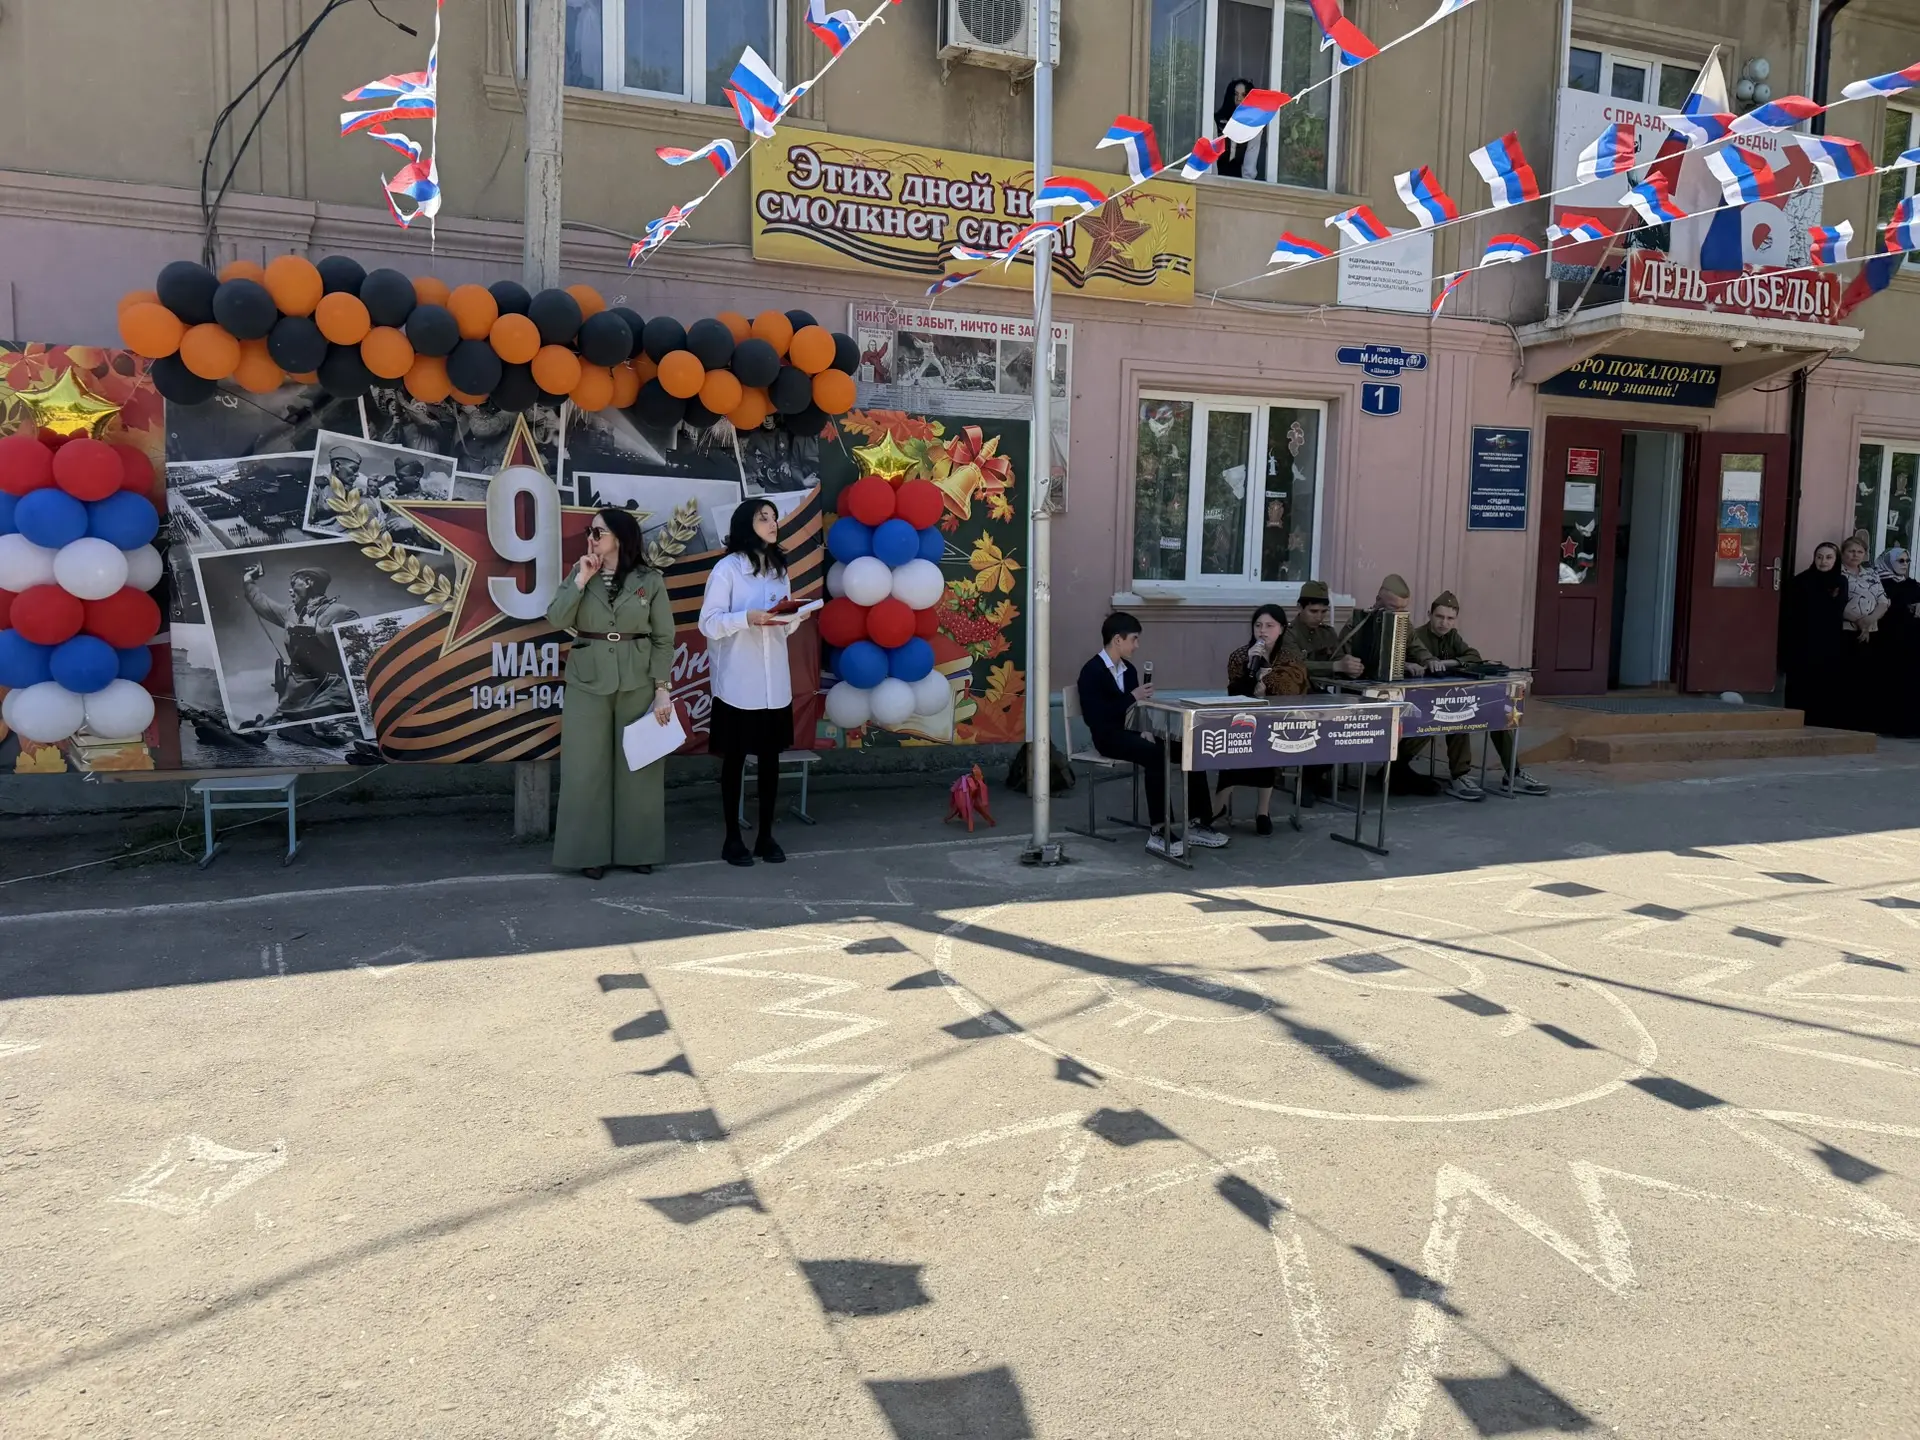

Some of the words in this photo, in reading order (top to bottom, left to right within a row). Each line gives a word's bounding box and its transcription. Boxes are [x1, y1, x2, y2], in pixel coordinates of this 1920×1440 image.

[1603, 107, 1612, 121] С
[1615, 109, 1672, 132] ПРАЗД
[1734, 135, 1777, 151] БЕДЫ!
[787, 145, 892, 200] Этих
[899, 171, 995, 214] дней
[1003, 186, 1036, 218] н
[757, 190, 949, 242] смолкнет
[956, 215, 1076, 259] слаа!
[1638, 258, 1708, 302] ДЕНЬ
[898, 313, 913, 326] НЕ
[916, 316, 958, 333] ЗАБЫТ,
[960, 319, 998, 334] НИЧТО
[1001, 324, 1015, 336] НЕ
[1360, 353, 1404, 366] М.Исаева
[1570, 359, 1604, 374] БРО
[1606, 360, 1716, 385] ПОЖАЛОВАТЬ
[1374, 387, 1385, 410] 1
[1579, 379, 1587, 390] в
[1589, 379, 1619, 396] мир
[1622, 382, 1680, 398] знаний!
[486, 464, 563, 620] 9
[492, 641, 560, 678] МАЯ
[470, 685, 564, 710] 1941-194
[1436, 697, 1455, 705] ПАРТА
[1456, 695, 1476, 704] ГЕРОЯ
[1228, 732, 1252, 740] ПРОЕКТ
[1273, 721, 1295, 731] ПАРТА
[1295, 720, 1317, 730] ГЕРОЯ
[1328, 728, 1385, 738] ОБЪЕДИНЯЮЩИЙ
[1227, 746, 1253, 755] ШКОЛА
[1228, 739, 1252, 747] НОВАЯ
[1334, 738, 1374, 746] ПОКОЛЕНИЯ
